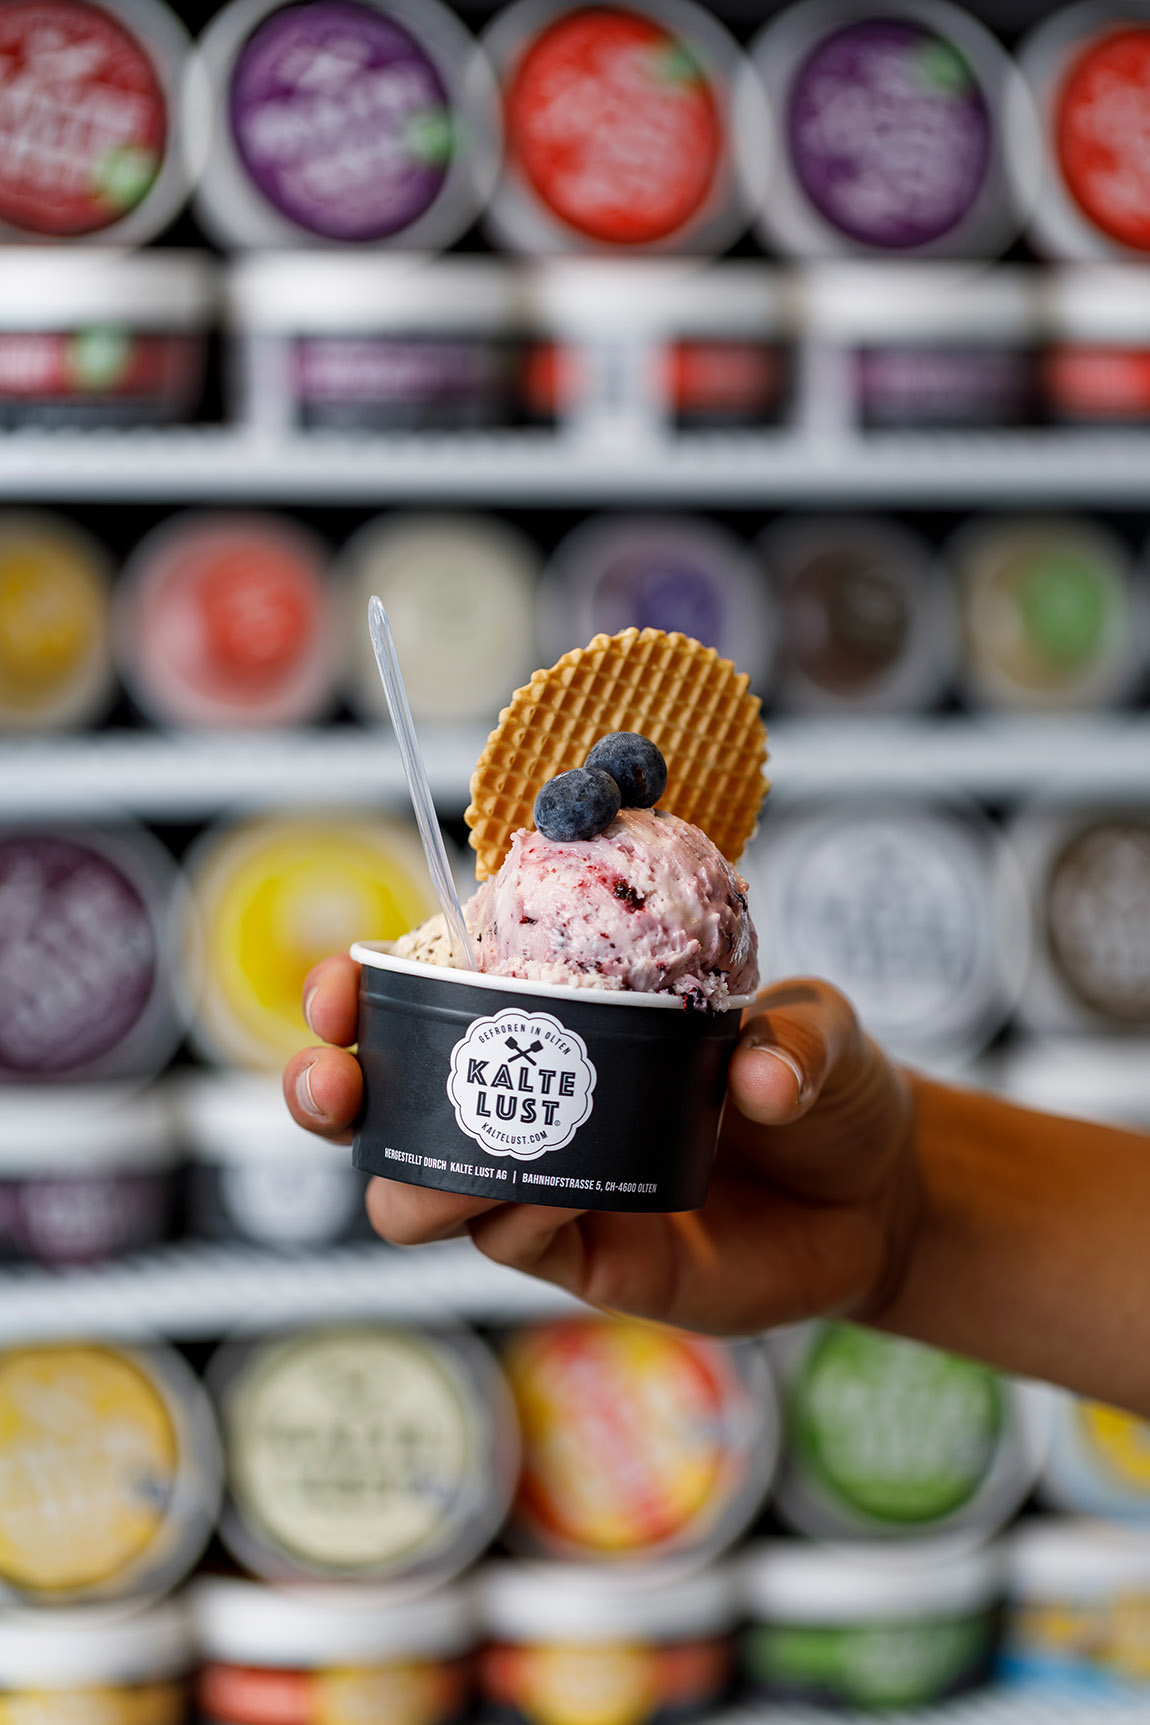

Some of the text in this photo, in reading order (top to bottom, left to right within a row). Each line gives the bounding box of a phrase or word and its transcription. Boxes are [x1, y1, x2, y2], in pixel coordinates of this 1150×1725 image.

[478, 1023, 572, 1055] GEFROREN IN OLTEN
[466, 1058, 576, 1097] KALTE
[481, 1122, 548, 1145] KALTELUST.COM
[384, 1147, 658, 1194] HERGESTELLT DURCH KALTE LUST AG BAHNHOFSTRASSE 5, CH-4600 OLTEN
